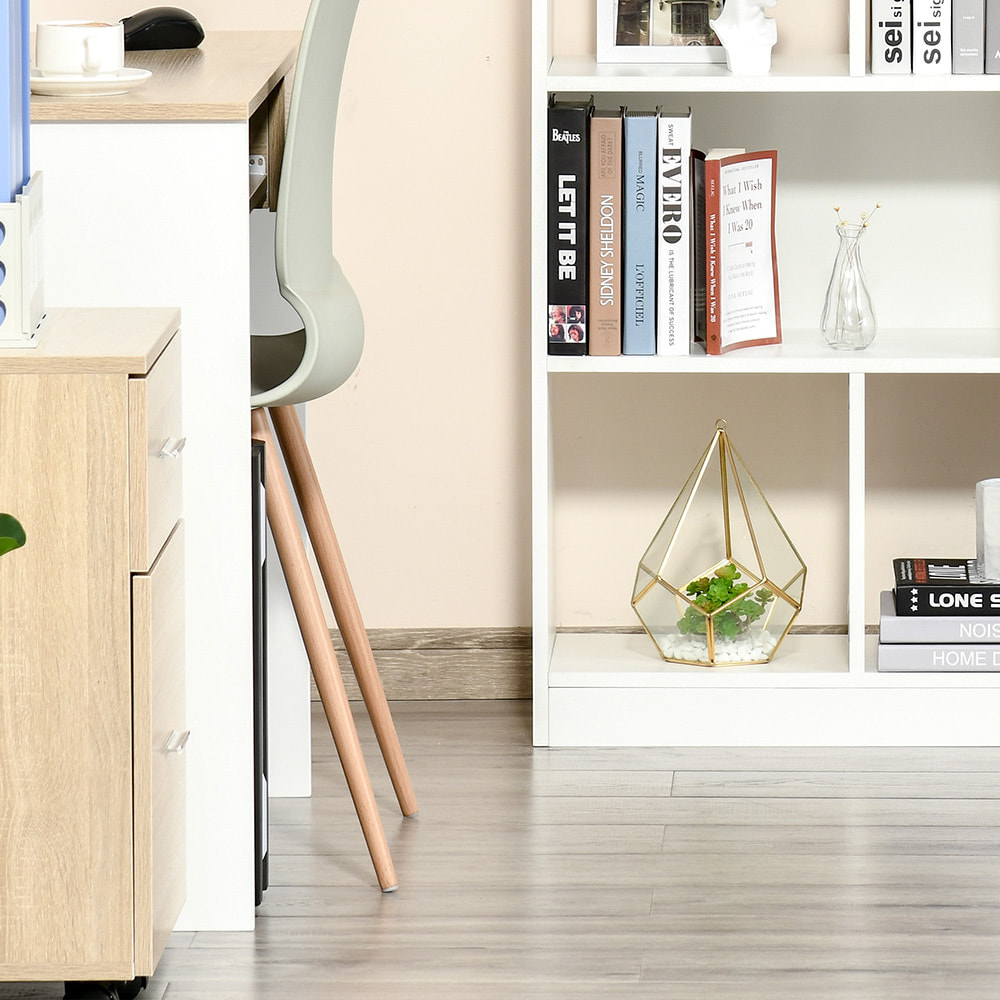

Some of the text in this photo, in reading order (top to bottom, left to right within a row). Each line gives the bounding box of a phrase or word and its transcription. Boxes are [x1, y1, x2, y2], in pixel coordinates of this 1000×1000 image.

[878, 21, 903, 64] sei
[917, 22, 942, 64] sei
[552, 128, 581, 144] BEATLES
[636, 174, 645, 212] MAGIC
[662, 148, 683, 244] EVERO
[743, 178, 763, 191] Wish
[725, 203, 741, 216] Knew
[741, 198, 763, 212] When
[731, 220, 744, 233] Was
[744, 218, 754, 231] 20
[558, 174, 577, 280] LET IT BE
[600, 195, 614, 258] SHELDON
[600, 260, 614, 306] SIDNEY
[635, 264, 645, 327] L'OFFICIEL
[668, 307, 675, 315] OF
[929, 593, 983, 609] LONE
[932, 651, 987, 666] HOME
